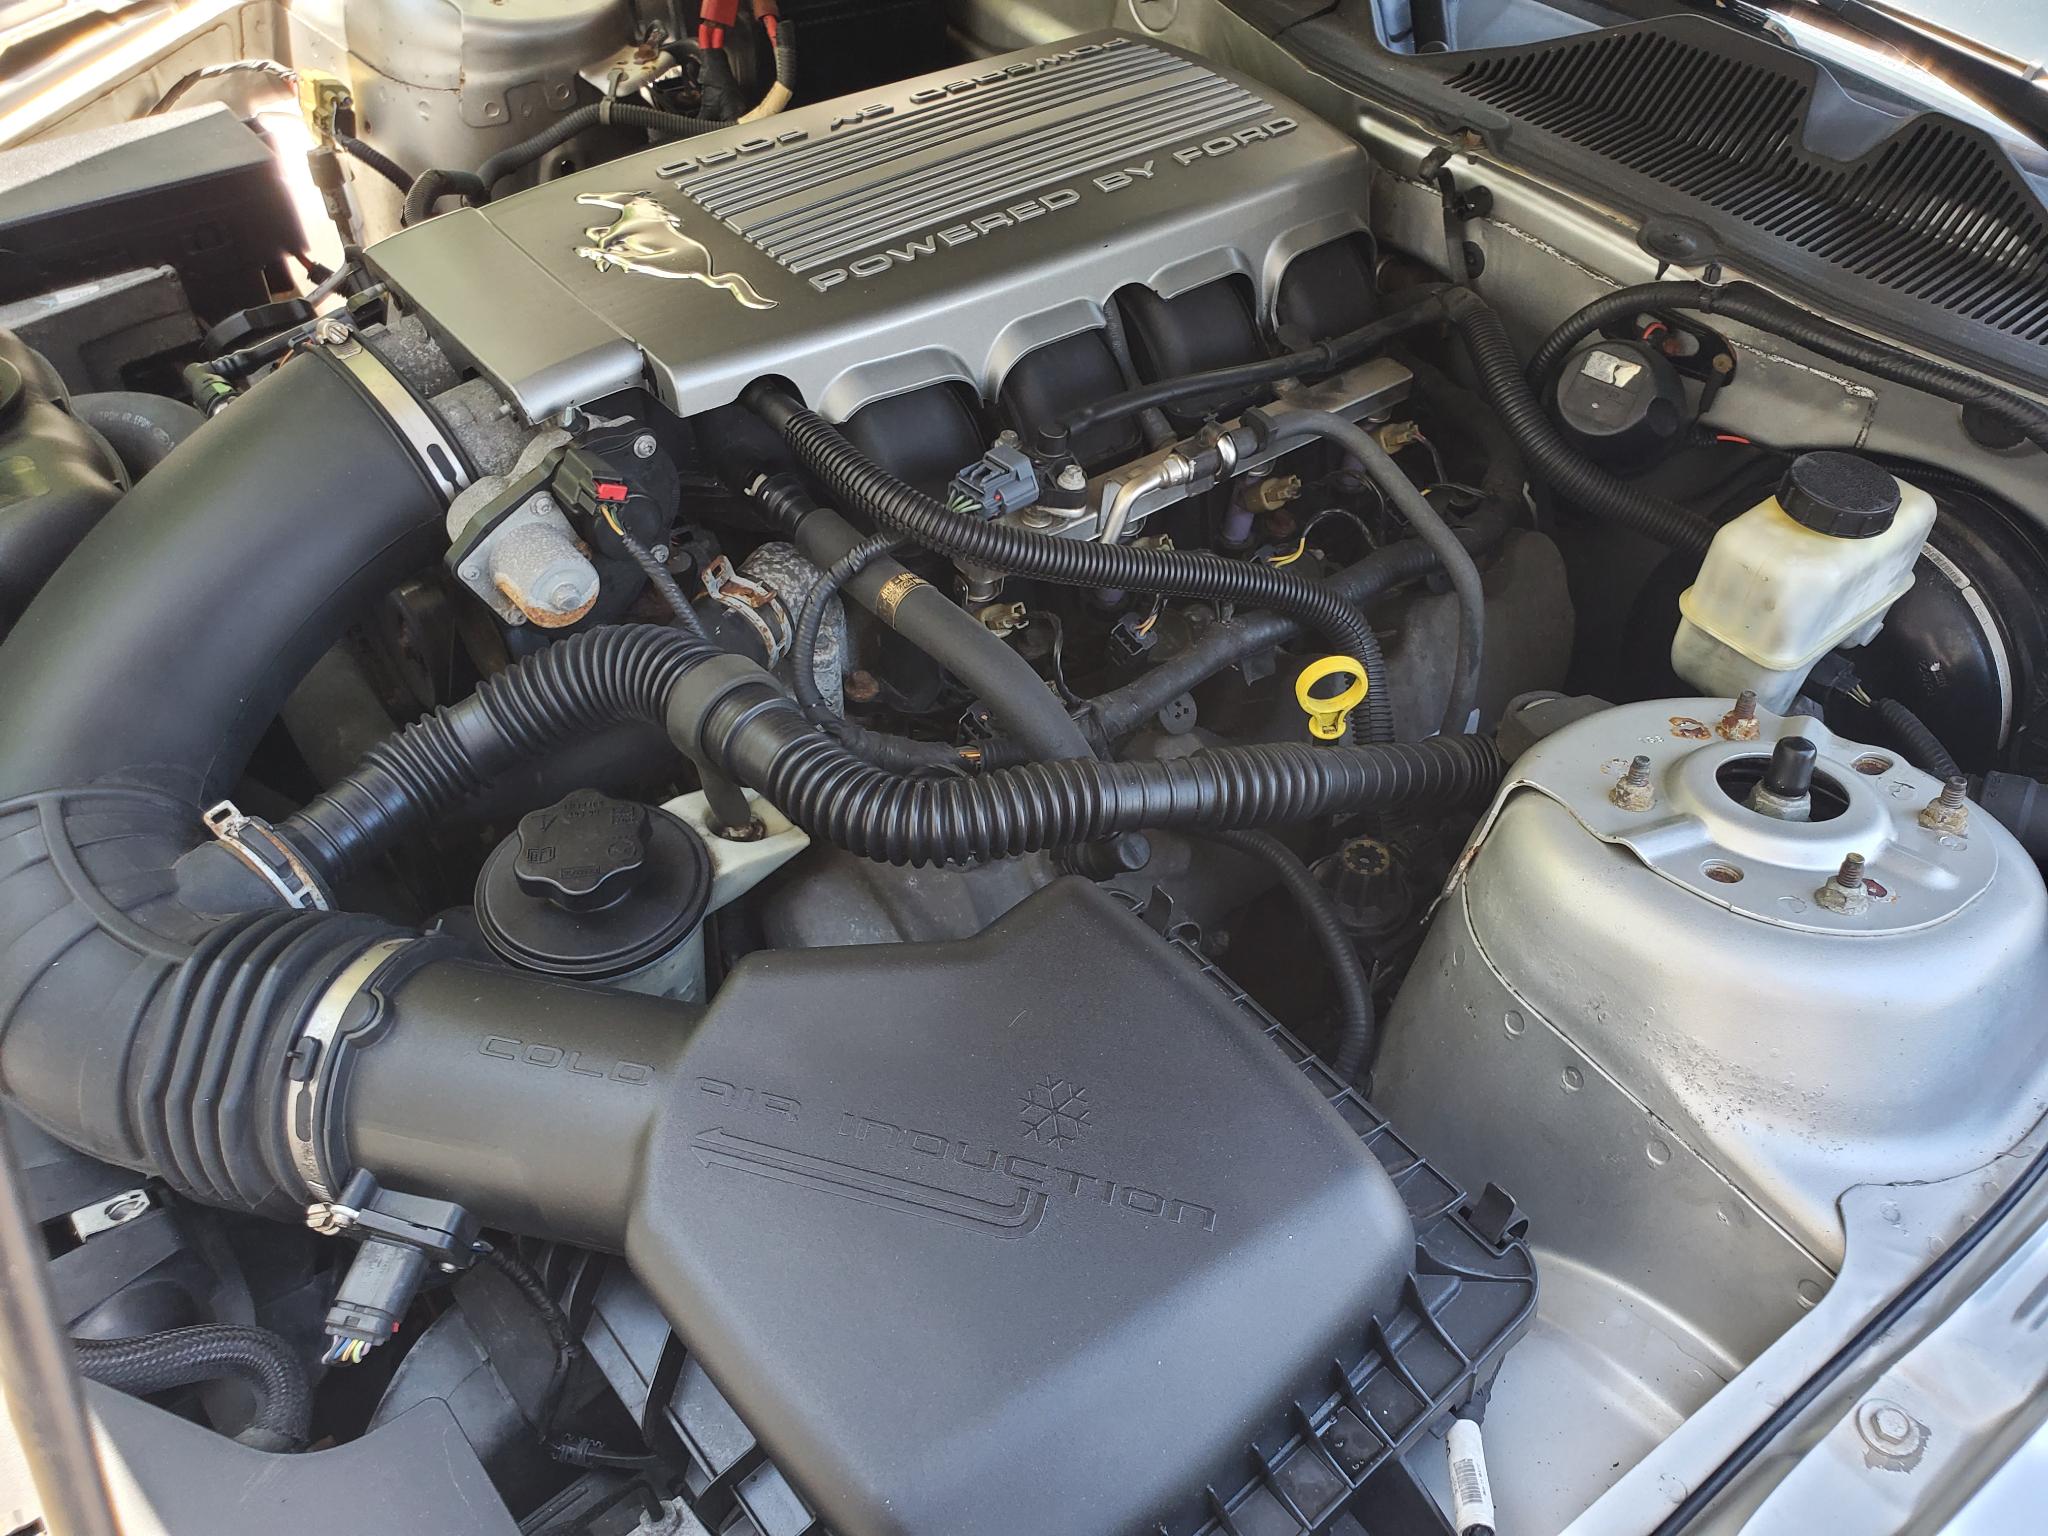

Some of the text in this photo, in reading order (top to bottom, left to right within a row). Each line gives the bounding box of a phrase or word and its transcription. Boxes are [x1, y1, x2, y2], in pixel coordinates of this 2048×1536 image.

[808, 117, 1298, 292] POWERED BY FORD
[479, 1034, 656, 1086] COLD
[696, 1076, 801, 1122] AIR
